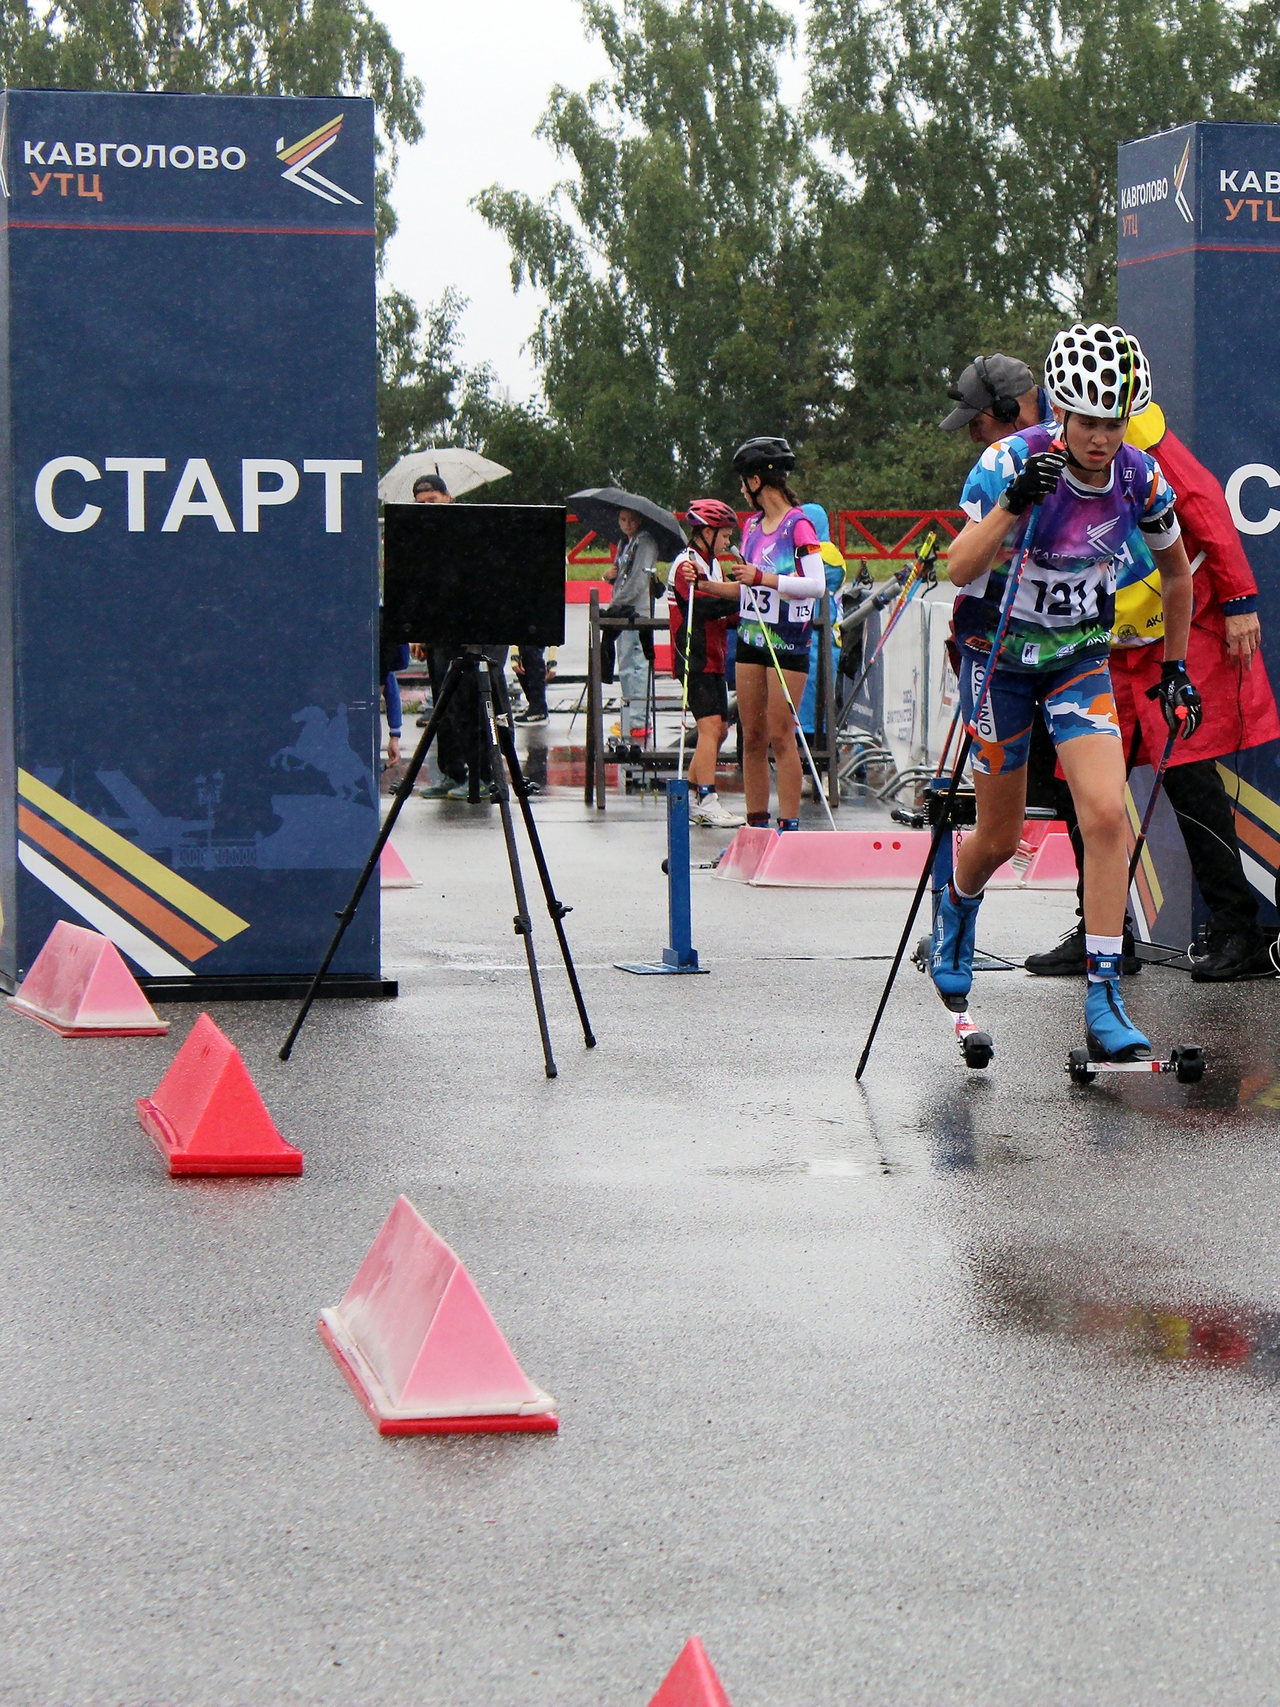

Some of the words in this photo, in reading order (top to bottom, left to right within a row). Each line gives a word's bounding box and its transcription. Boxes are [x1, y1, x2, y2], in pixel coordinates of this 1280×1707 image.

[24, 141, 246, 171] КАВГОЛОВО
[31, 171, 104, 201] УТЦ
[1121, 176, 1169, 210] КАВГОЛОВО
[1122, 214, 1139, 238] УТЦ
[34, 455, 363, 534] СТАРТ
[1031, 579, 1087, 616] 121
[933, 915, 945, 967] SPINE
